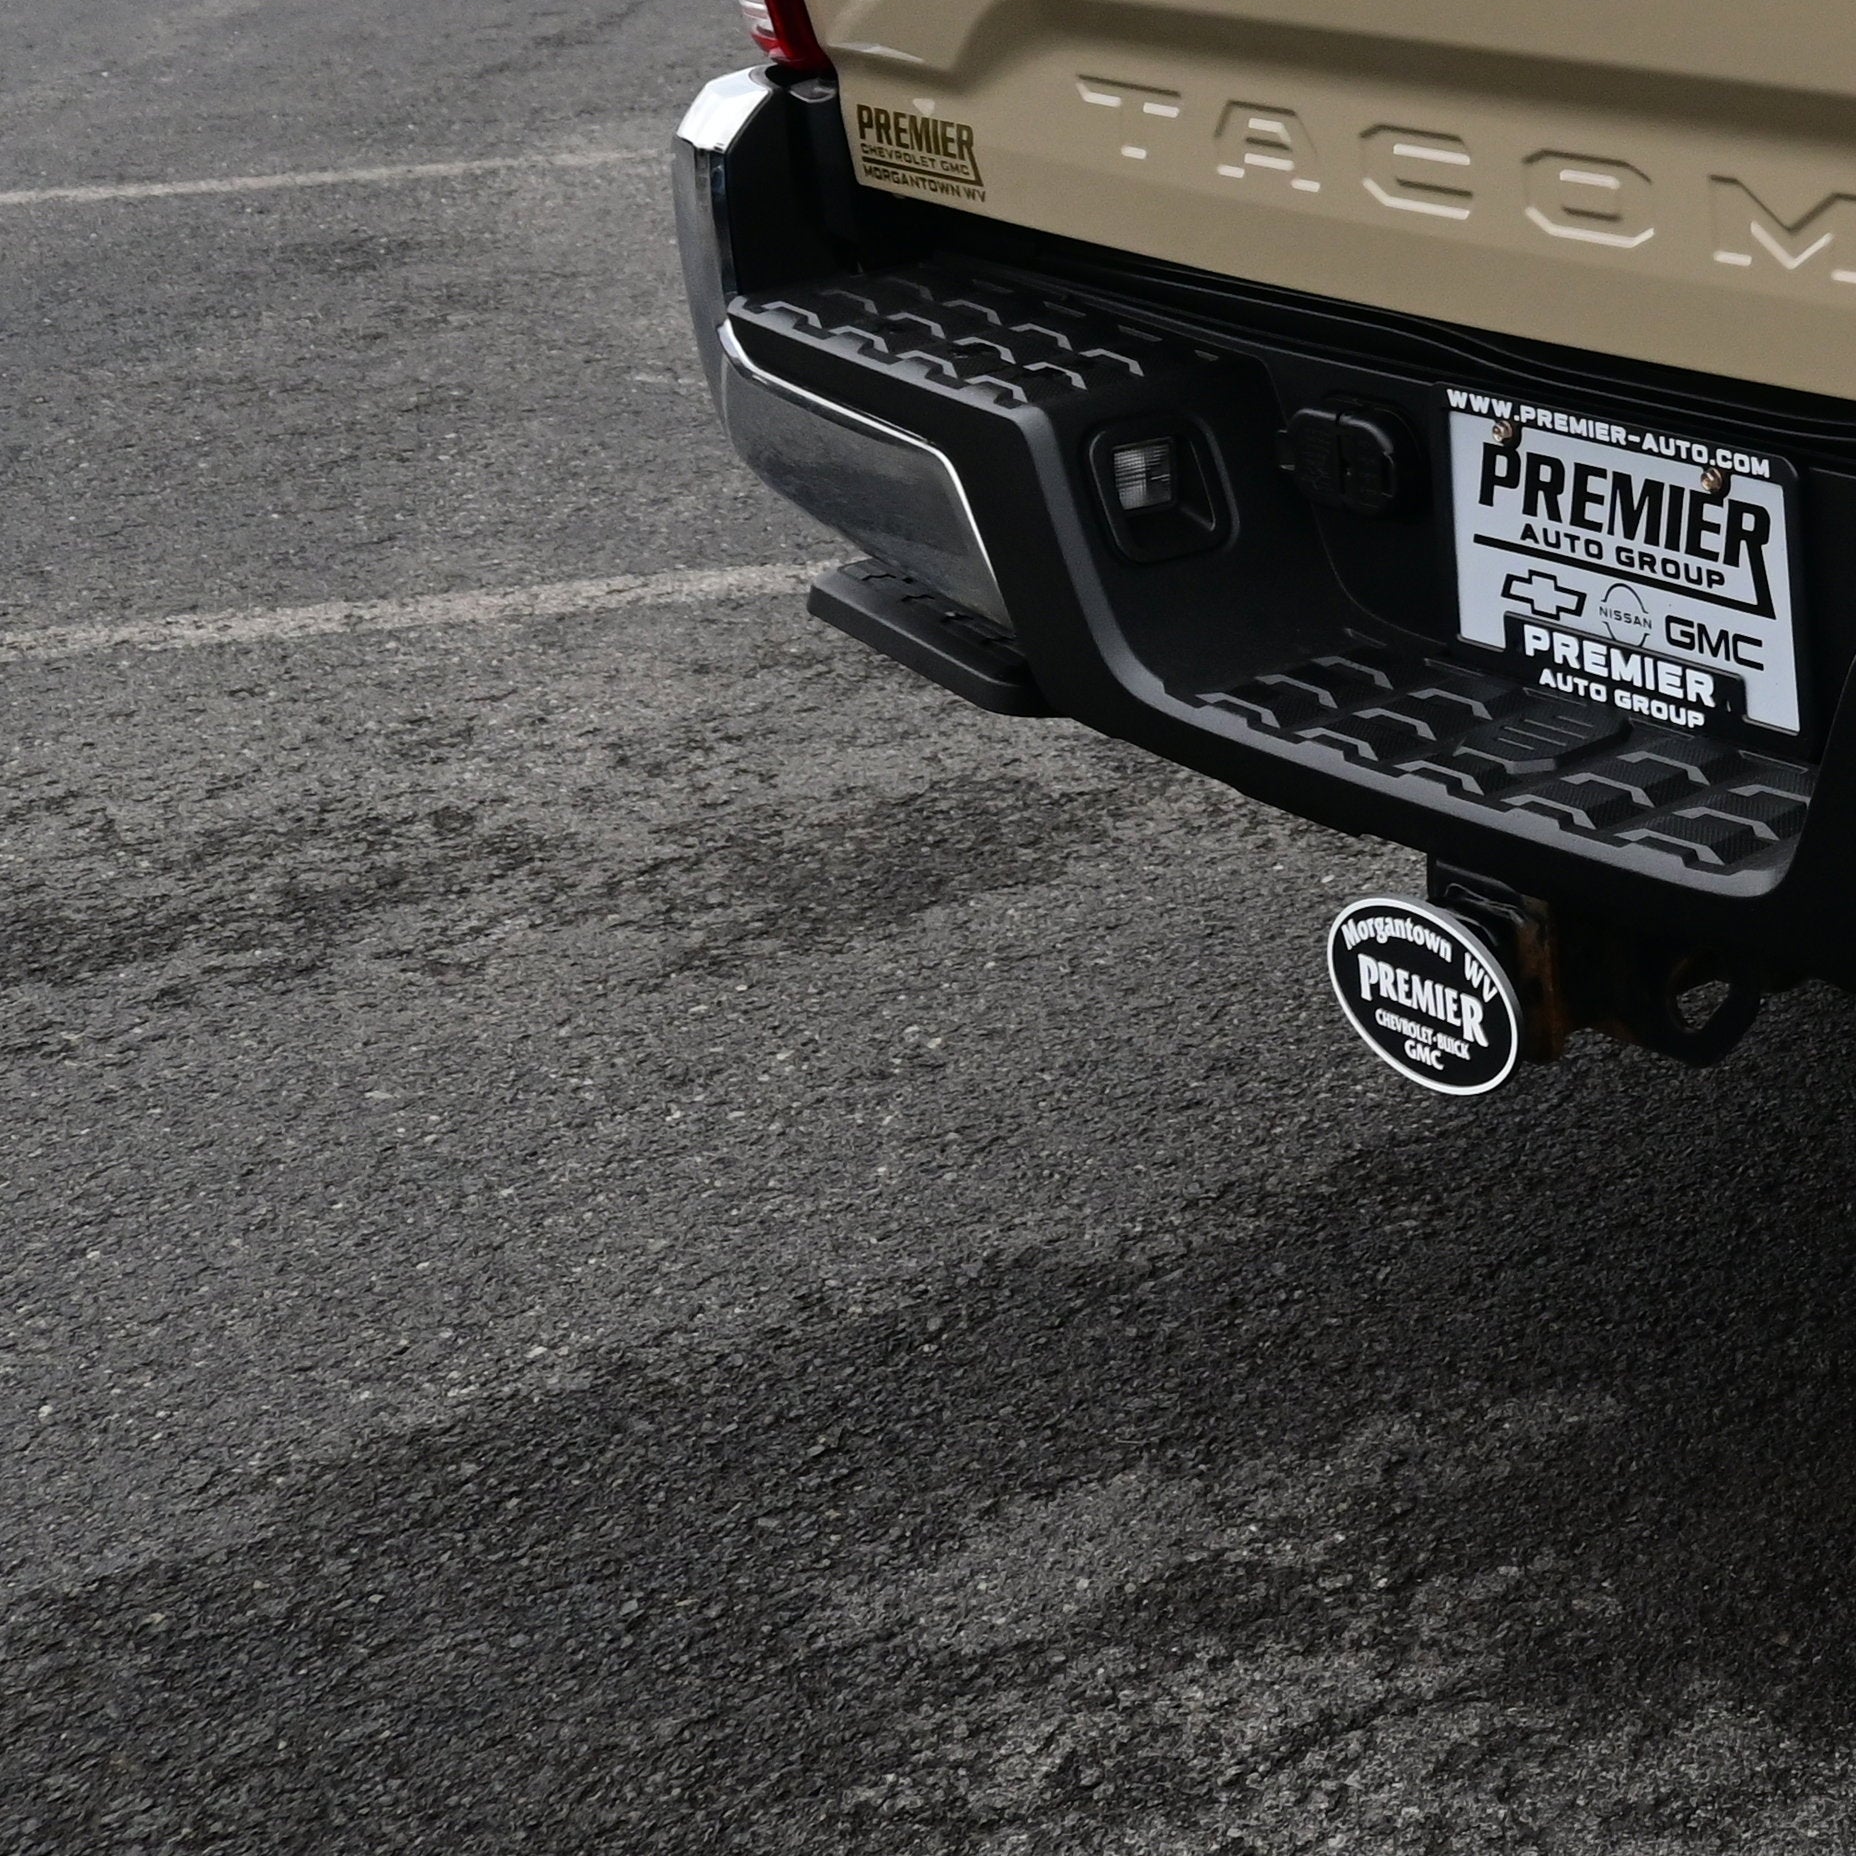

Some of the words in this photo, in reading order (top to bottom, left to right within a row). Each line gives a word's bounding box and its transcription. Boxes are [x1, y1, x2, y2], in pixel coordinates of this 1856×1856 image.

[857, 104, 975, 161] PREMIER
[860, 143, 936, 169] CHEVROLET
[941, 159, 970, 176] GMC
[863, 165, 961, 197] MORGANTOWN
[962, 186, 986, 203] WV
[1447, 388, 1771, 479] WWW.PREMIER-AUTO.COM
[1478, 441, 1772, 569] PREMIER
[1520, 523, 1604, 561] AUTO
[1615, 546, 1725, 590] GROUP
[1599, 606, 1652, 630] NISSAN
[1665, 614, 1764, 671] GMC
[1523, 624, 1715, 708] PREMIER
[1539, 668, 1606, 703] AUTO
[1614, 690, 1705, 729] GROUP
[1341, 916, 1452, 963] Morgantown
[1464, 951, 1498, 1003] WV
[1358, 953, 1489, 1047] PREMIER
[1404, 1039, 1444, 1070] GMC
